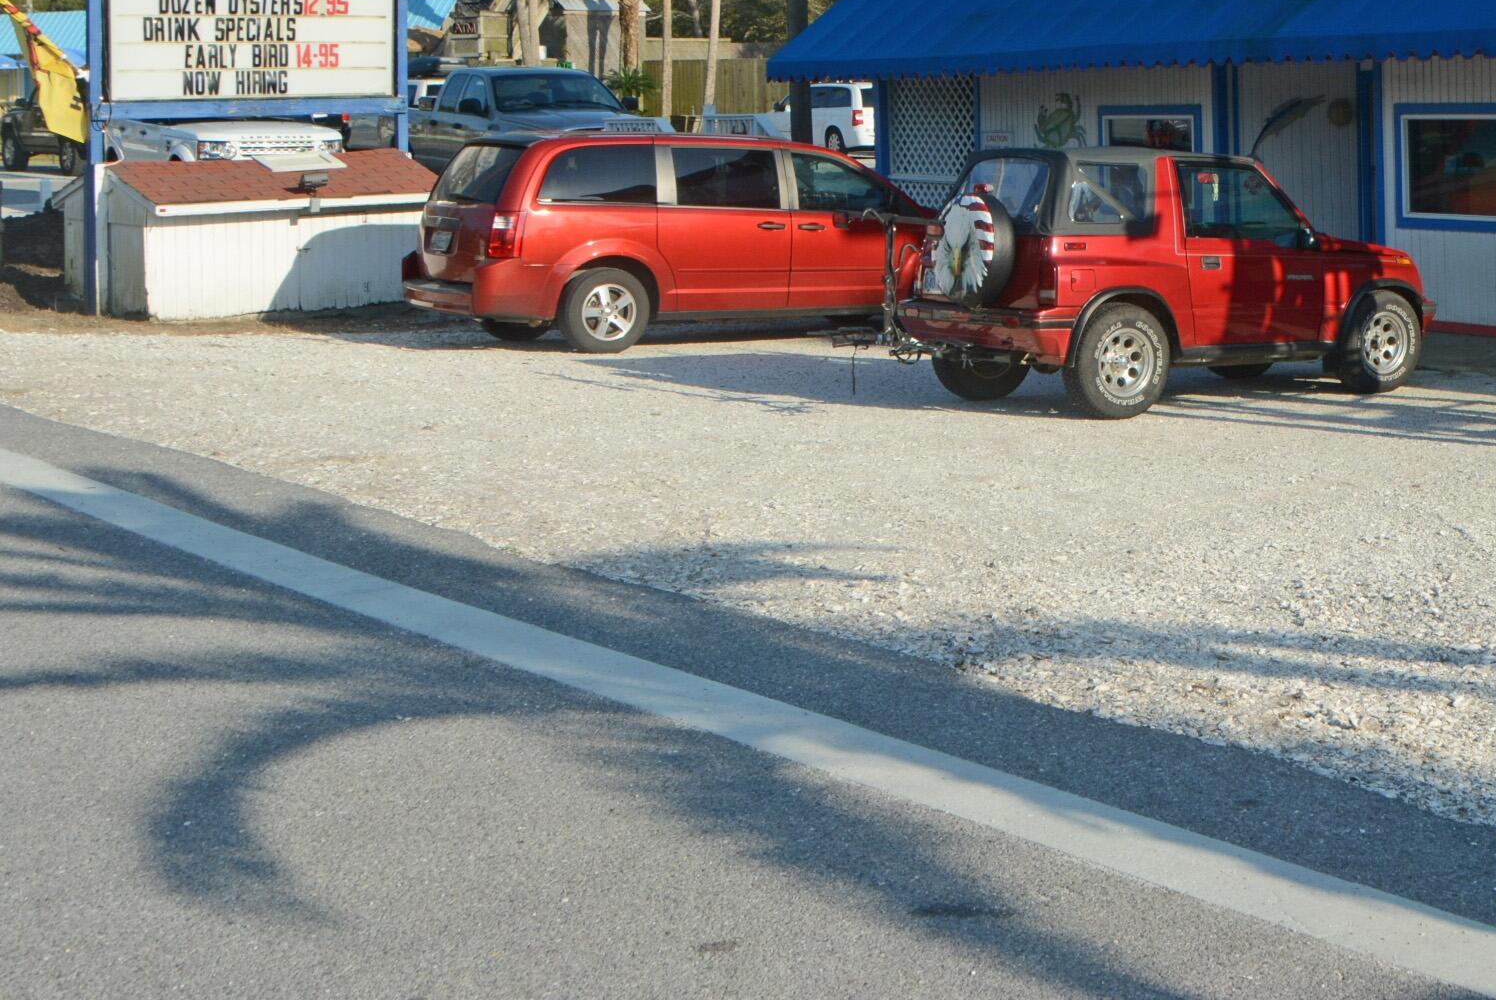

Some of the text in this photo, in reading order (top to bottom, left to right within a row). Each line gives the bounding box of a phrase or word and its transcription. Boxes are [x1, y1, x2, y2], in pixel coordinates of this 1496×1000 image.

[143, 17, 296, 42] DRINK SPECIALS
[185, 44, 238, 69] EARLY
[252, 44, 289, 68] BIRD
[183, 71, 288, 96] NOW HIRING
